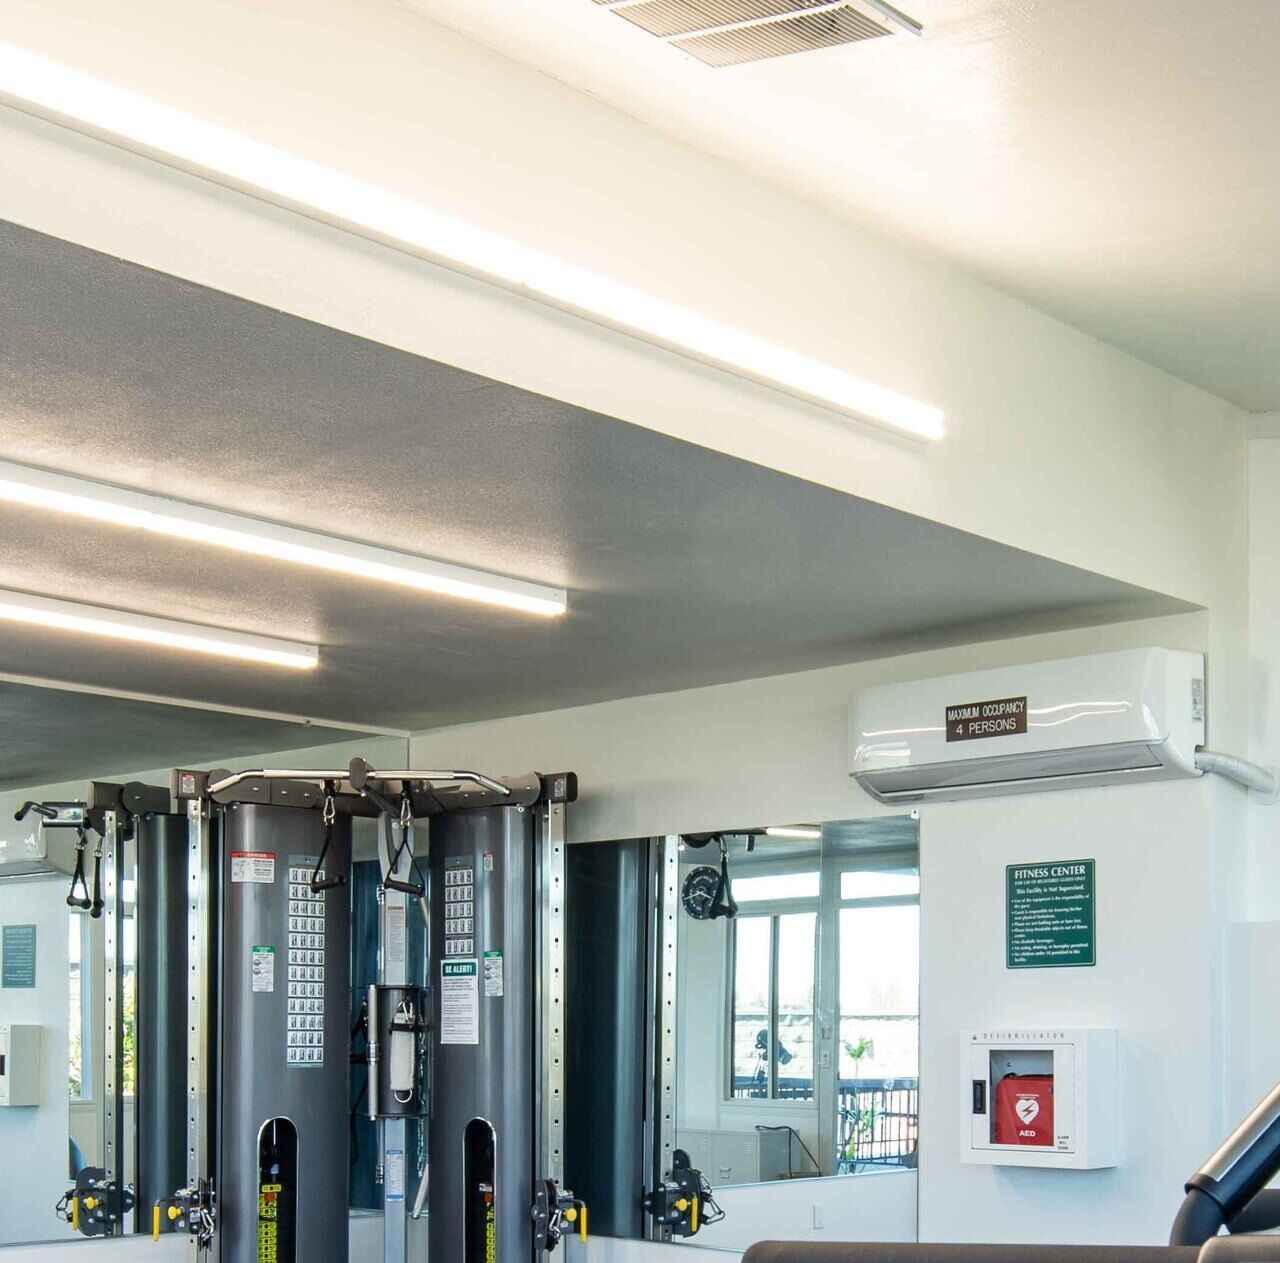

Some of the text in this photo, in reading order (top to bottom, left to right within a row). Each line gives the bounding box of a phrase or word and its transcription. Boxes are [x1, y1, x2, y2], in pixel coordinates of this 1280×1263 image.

[948, 701, 1024, 720] MAXIMUM OCCUPANCY
[956, 718, 1016, 735] 4 PERSONS
[1015, 865, 1086, 879] FITNESS CENTER
